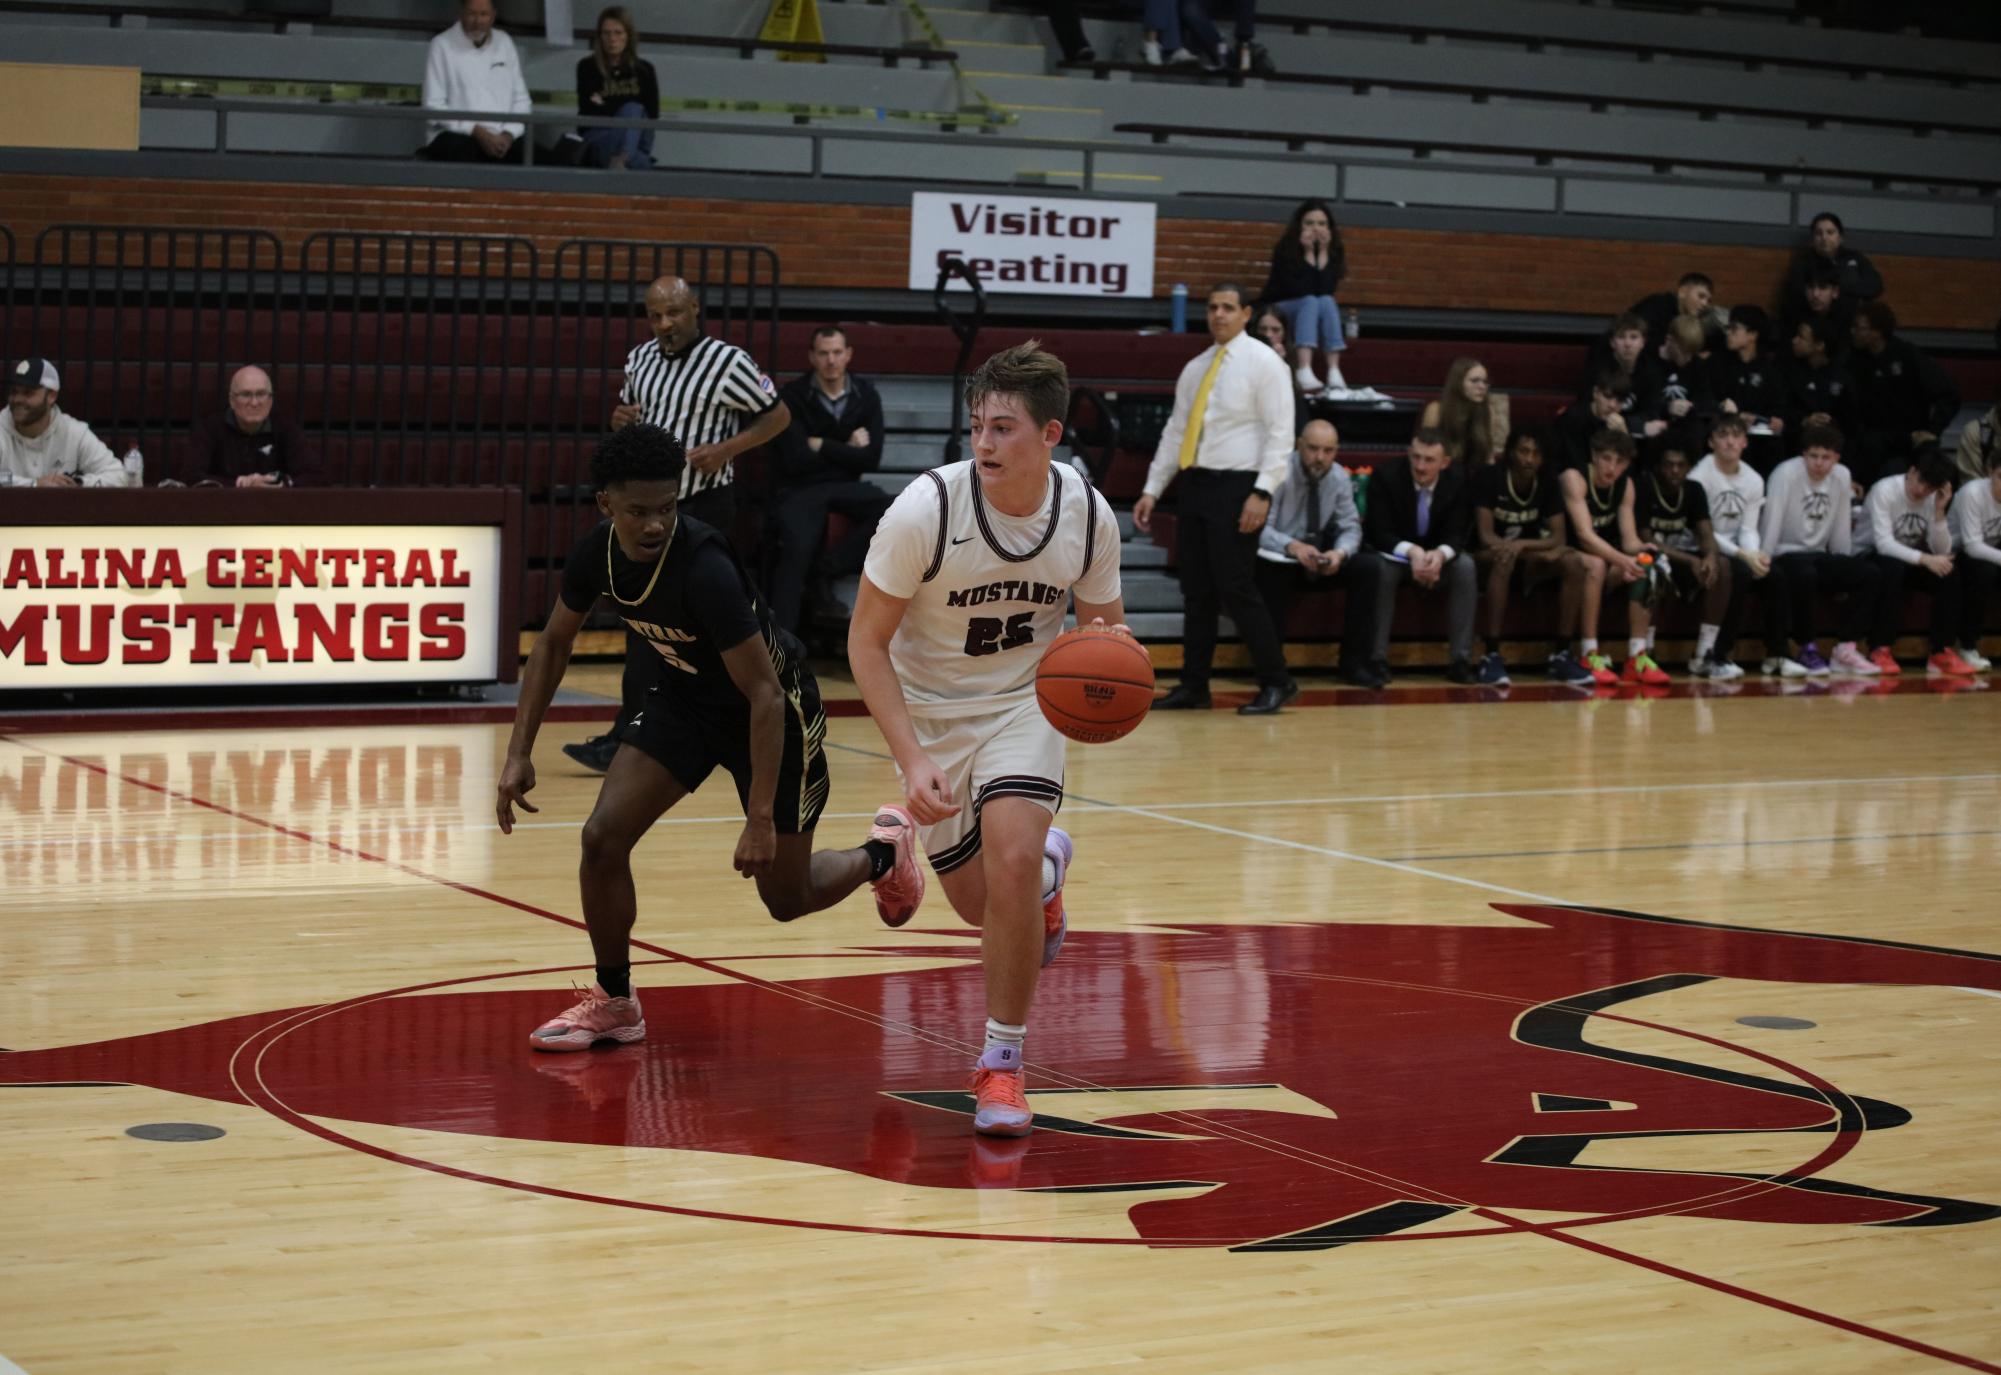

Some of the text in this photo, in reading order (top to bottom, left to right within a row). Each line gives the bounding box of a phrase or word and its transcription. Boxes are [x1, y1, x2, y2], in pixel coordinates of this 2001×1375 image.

[951, 203, 1120, 239] Visitor
[0, 548, 471, 589] ALINA CENTRAL
[0, 602, 466, 666] MUSTANGS
